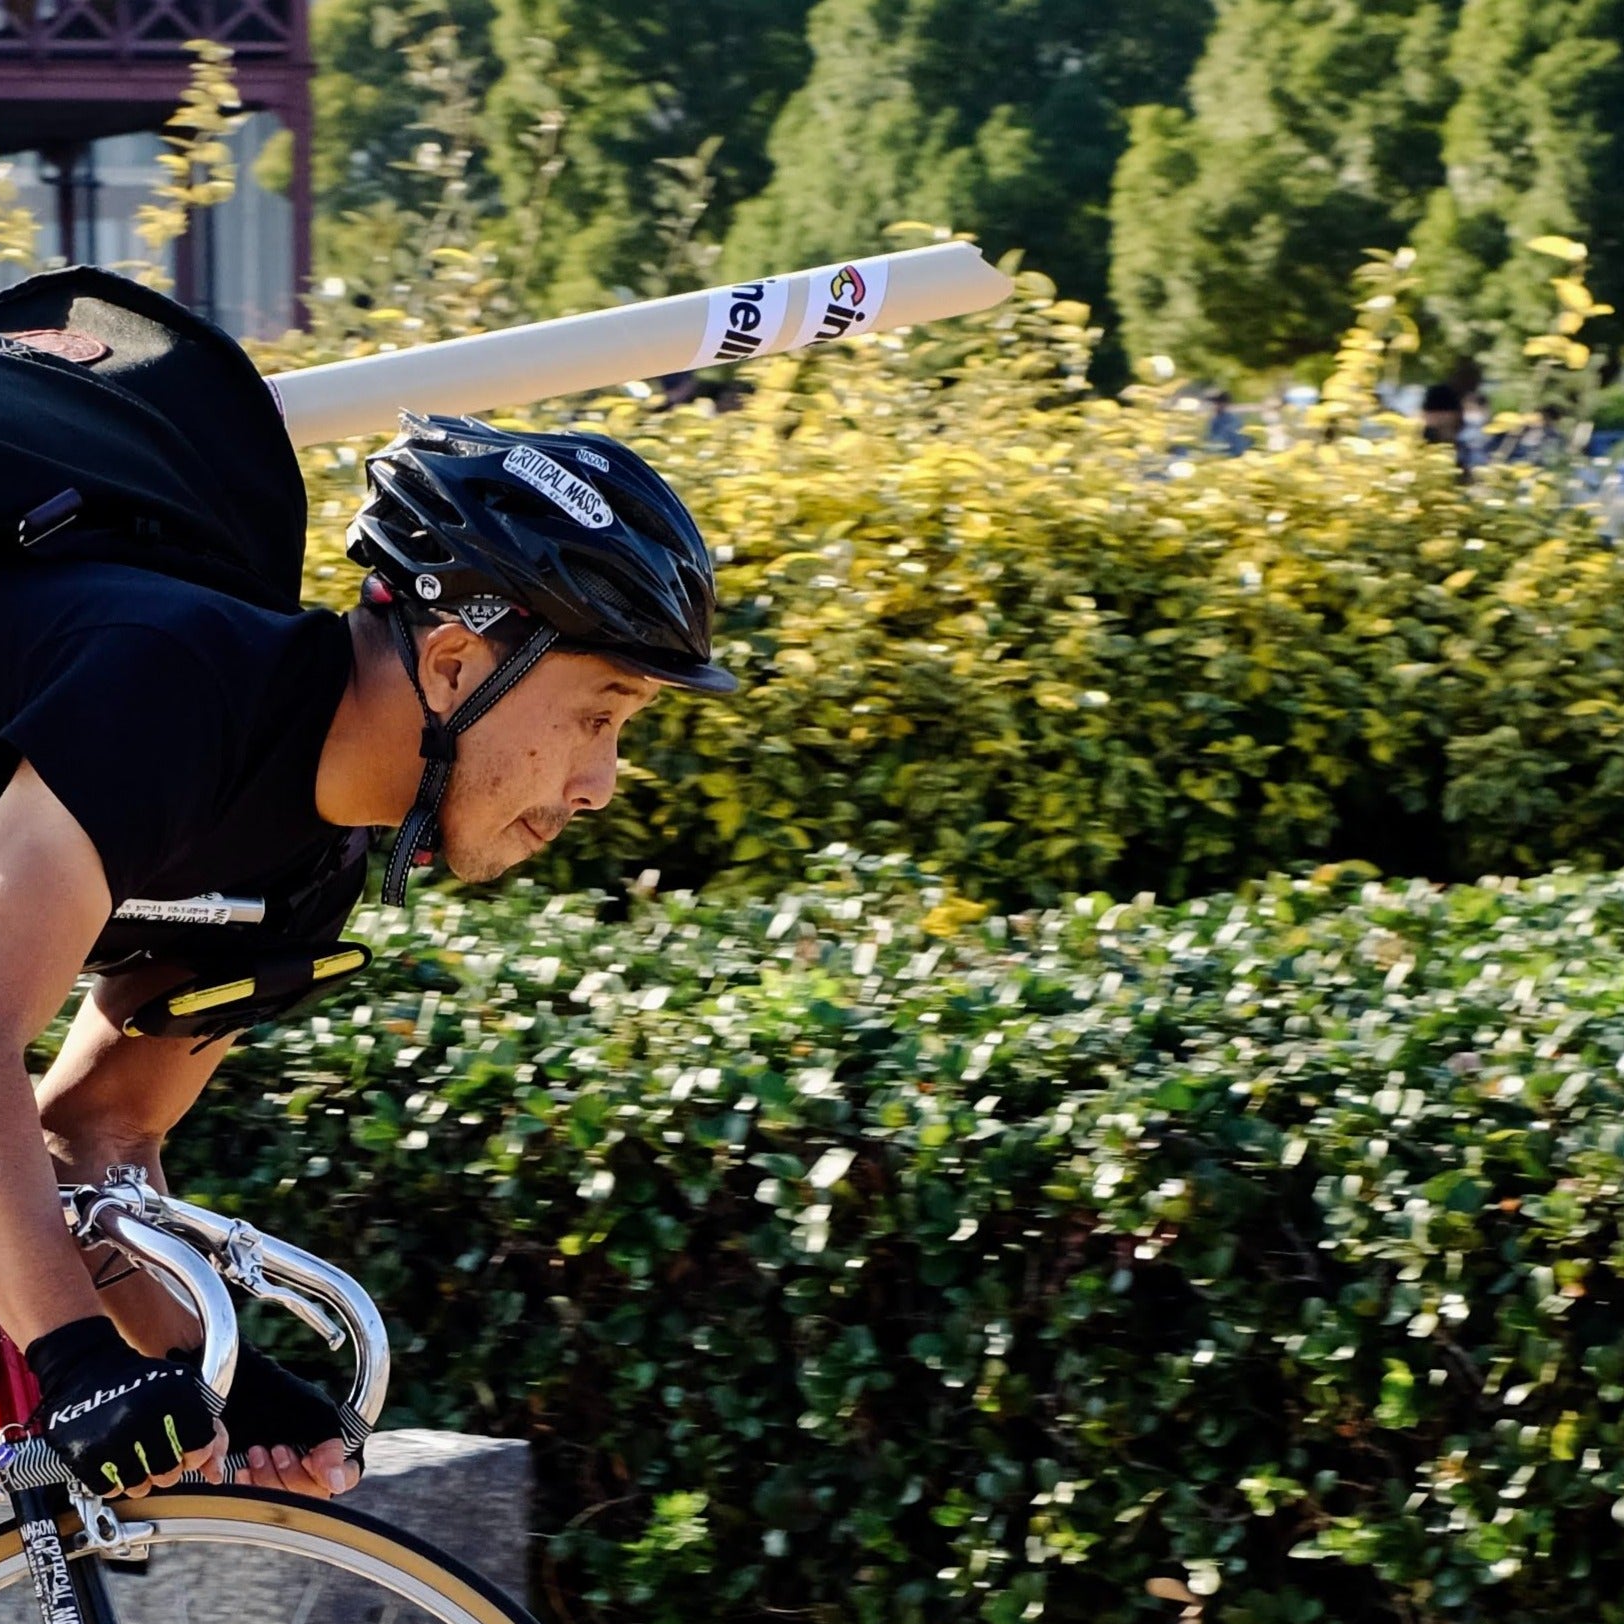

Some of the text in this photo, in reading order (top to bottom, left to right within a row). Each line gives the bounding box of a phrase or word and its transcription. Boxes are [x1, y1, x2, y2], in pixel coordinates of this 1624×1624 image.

[714, 280, 776, 359] nelli
[803, 265, 866, 347] Cin
[508, 447, 567, 494] CRITICAL
[562, 481, 601, 515] MASS
